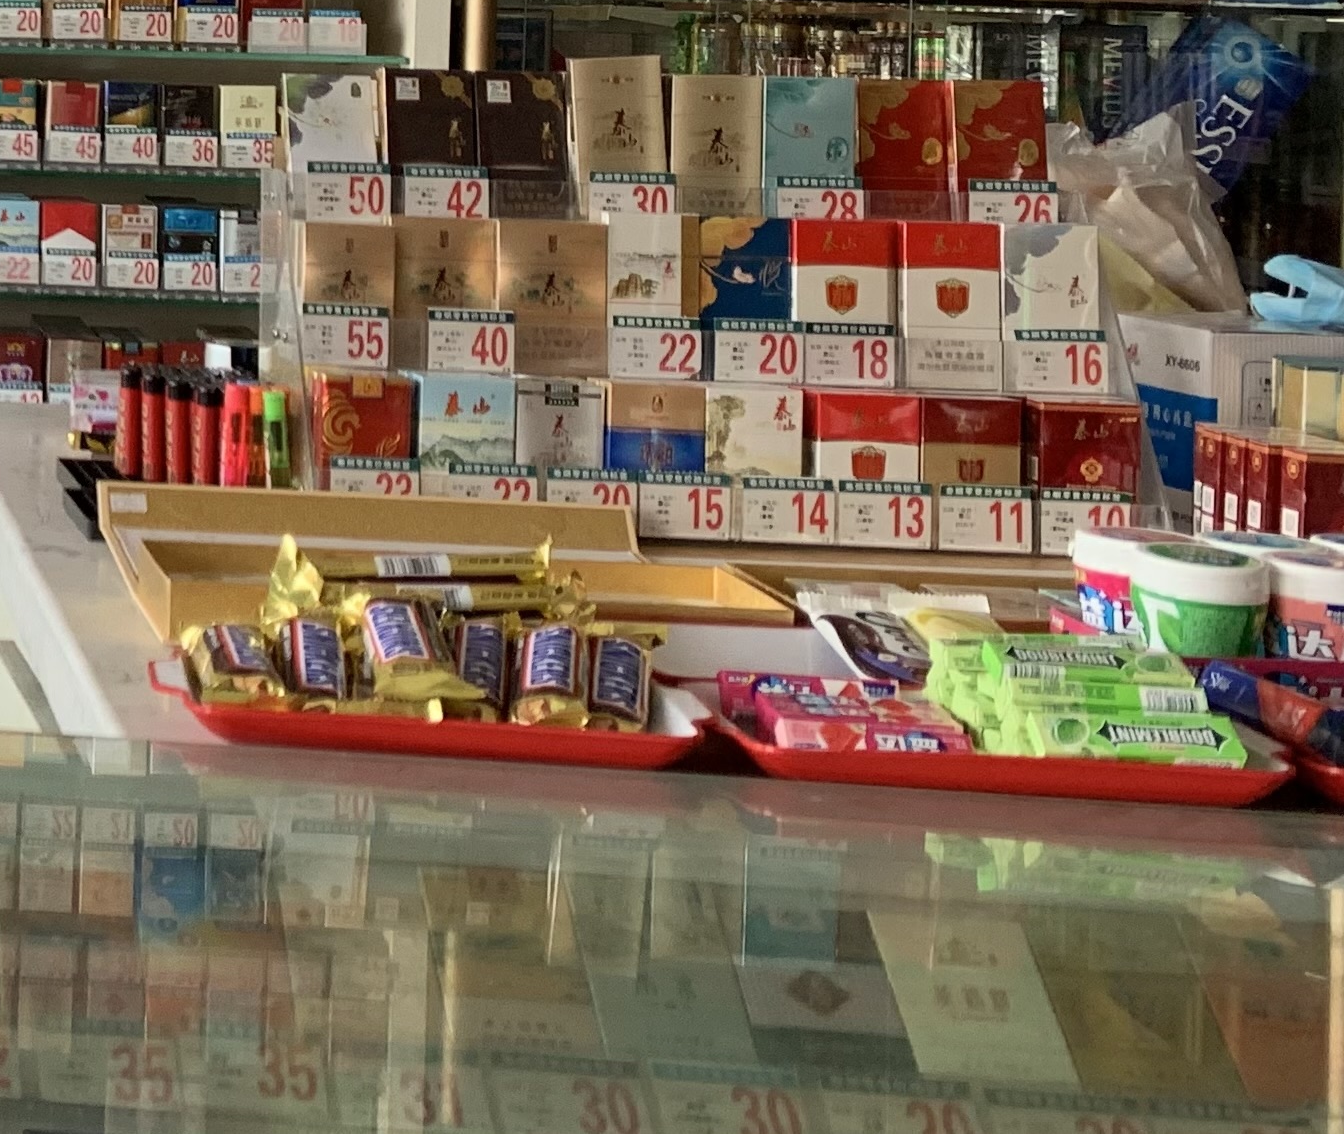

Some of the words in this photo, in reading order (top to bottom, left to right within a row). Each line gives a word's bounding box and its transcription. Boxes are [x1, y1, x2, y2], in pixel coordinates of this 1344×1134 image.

[18, 10, 41, 31] 20
[80, 11, 105, 34] 20
[146, 14, 167, 37] 20
[13, 134, 35, 156] 45
[76, 135, 96, 158] 45
[132, 137, 154, 157] 40
[194, 139, 214, 162] 36
[349, 177, 384, 215] 50
[448, 182, 481, 219] 42
[634, 186, 668, 213] 30
[818, 192, 861, 221] 28
[1015, 194, 1050, 222] 26
[348, 321, 384, 359] 55
[472, 327, 507, 365] 40
[659, 334, 696, 373] 22
[760, 335, 797, 374] 20
[853, 340, 887, 379] 18
[1066, 344, 1101, 384] 16
[444, 389, 491, 417] 泰山
[688, 489, 722, 529] 15
[793, 494, 828, 532] 14
[889, 497, 924, 538] 13
[990, 502, 1023, 542] 11
[1014, 647, 1117, 668] DOUBLEMINT
[1108, 726, 1218, 747] DOUBLEMINT
